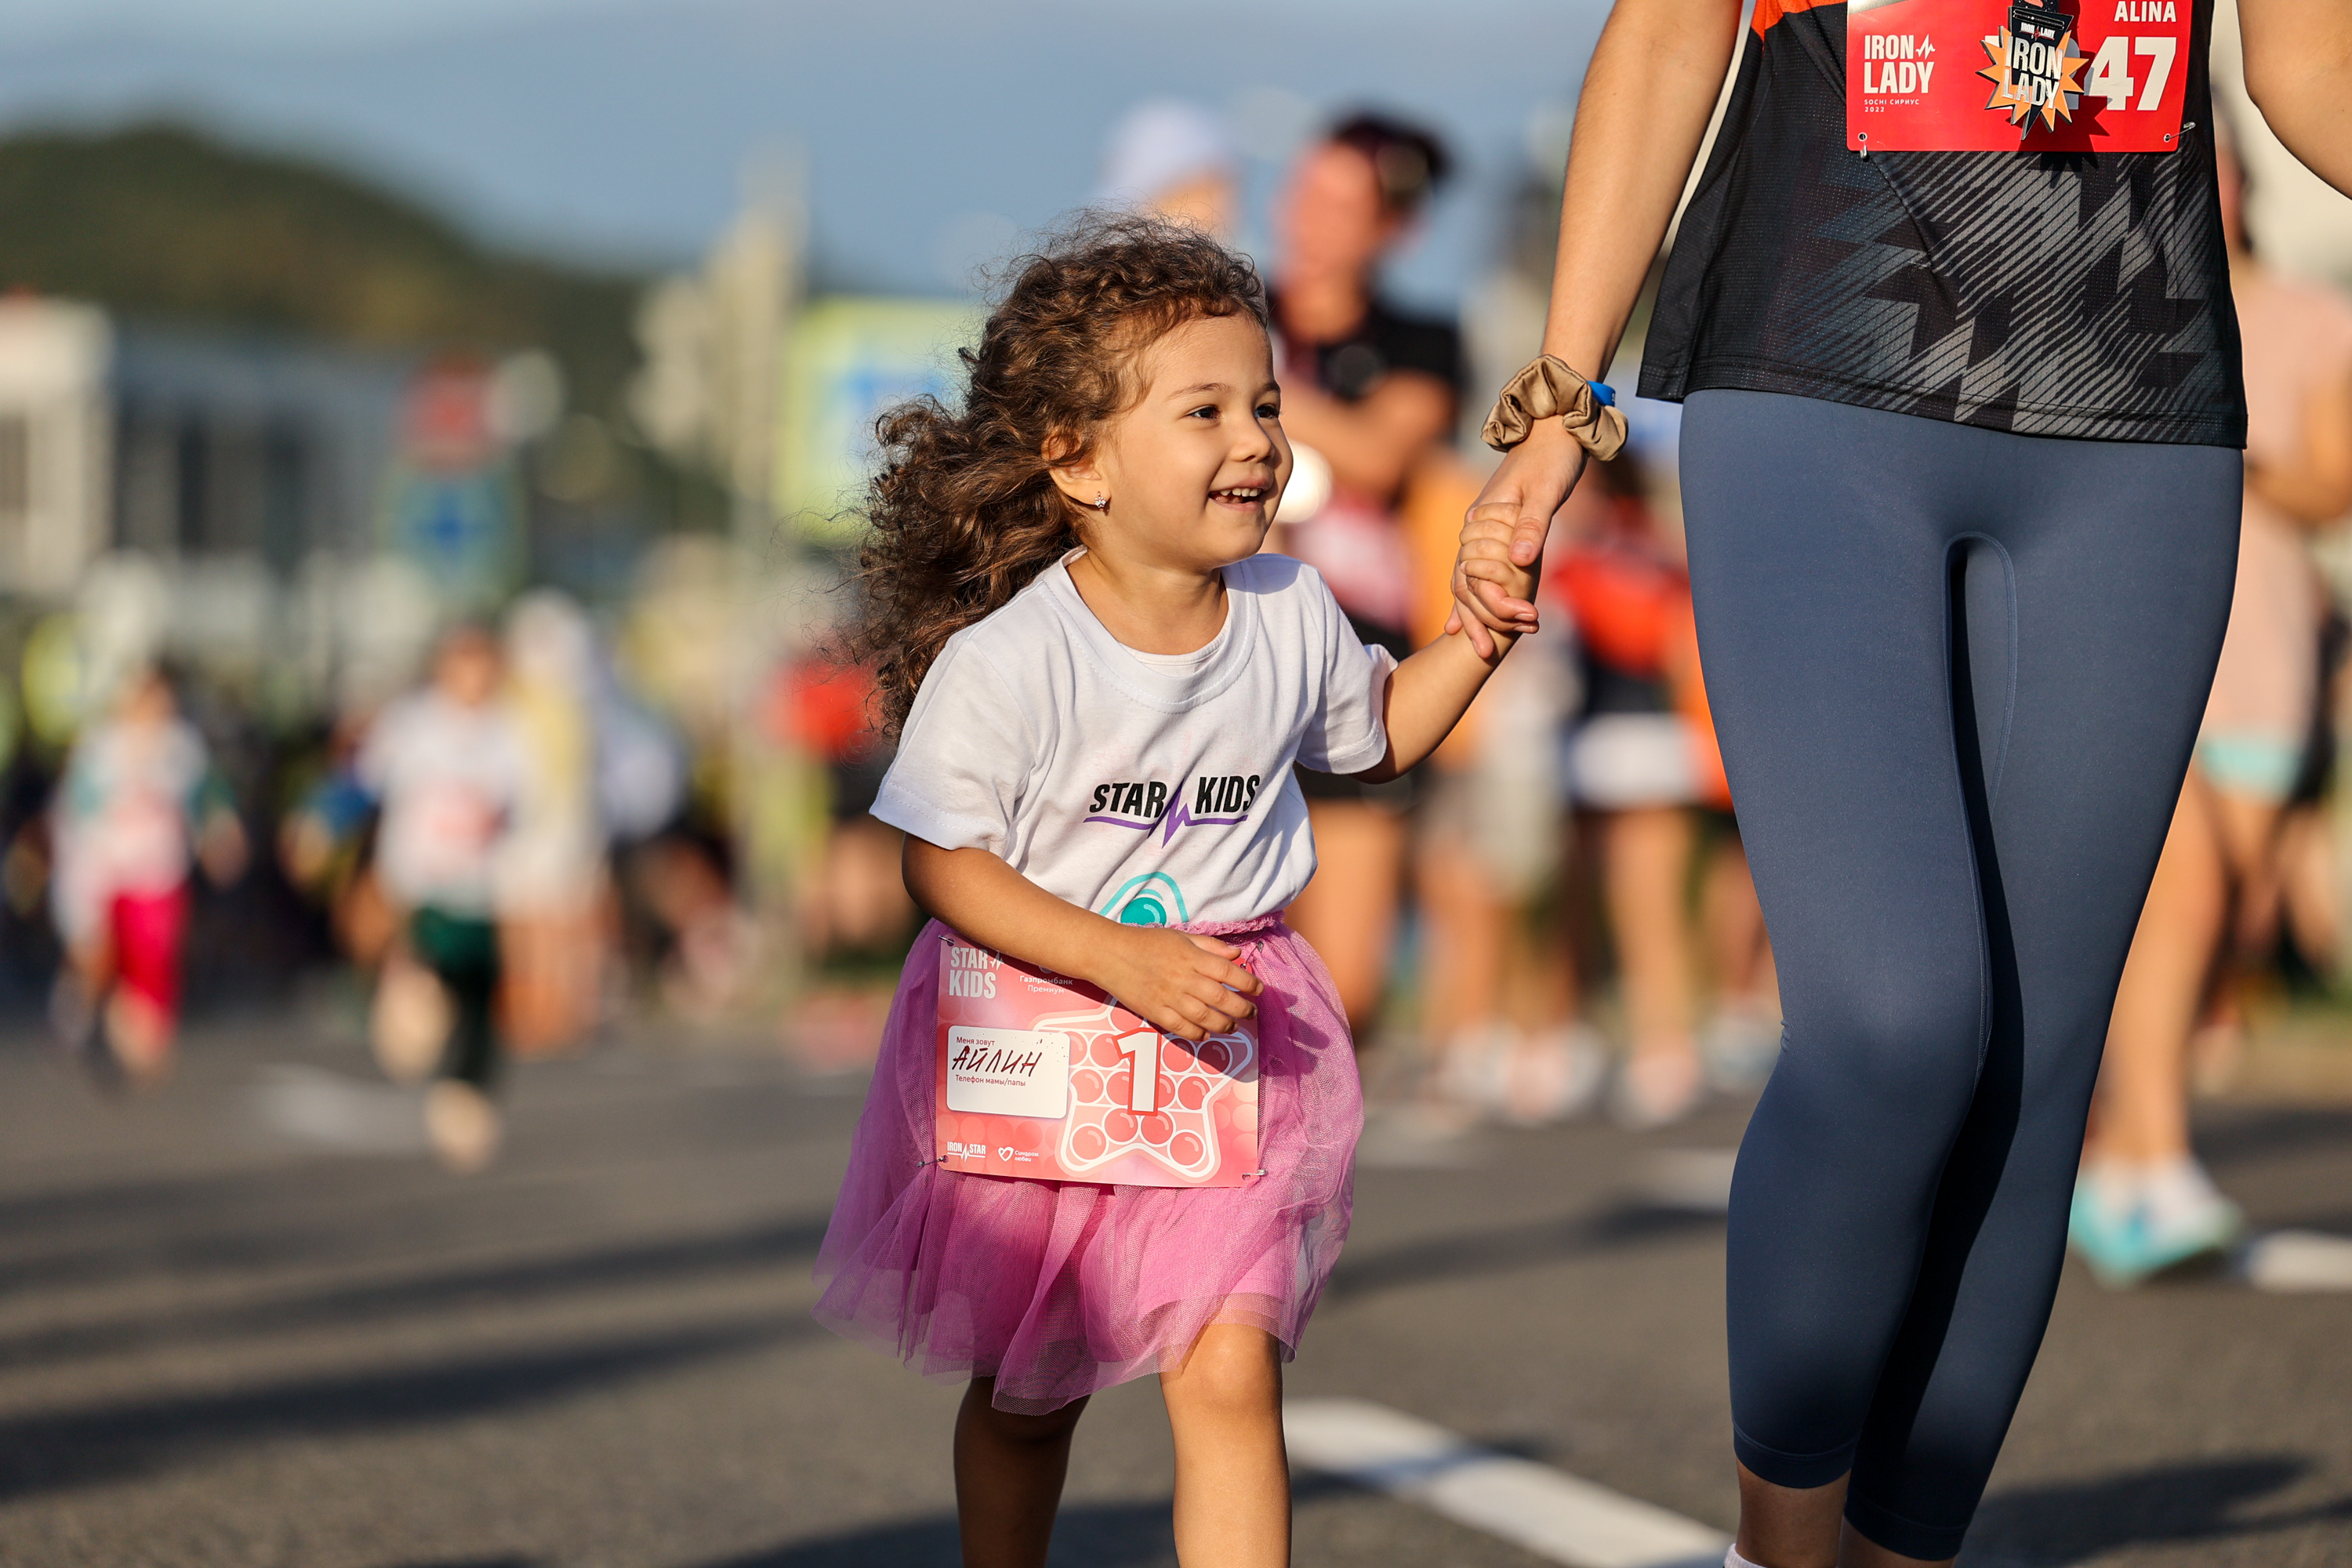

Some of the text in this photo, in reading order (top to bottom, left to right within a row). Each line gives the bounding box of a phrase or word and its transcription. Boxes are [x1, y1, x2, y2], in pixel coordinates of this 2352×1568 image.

[2114, 1, 2176, 22] ALINA
[2020, 22, 2056, 38] IRON LADY
[1864, 34, 1915, 60] IRON
[2005, 35, 2064, 80] IRON
[1864, 61, 1935, 93] LADY
[2002, 67, 2060, 109] LADY
[1089, 775, 1261, 818] STAR KIDS
[950, 946, 989, 970] STAR
[949, 969, 997, 999] KIDS
[1019, 975, 1073, 985] Газпромбанк
[1027, 985, 1065, 994] Премиум
[956, 1036, 975, 1044] Меня
[951, 1045, 1043, 1077] АЙЛИН
[1112, 1028, 1160, 1116] 1
[955, 1074, 1026, 1087] Телефон мамы/папы
[947, 1141, 986, 1155] IRON STAR
